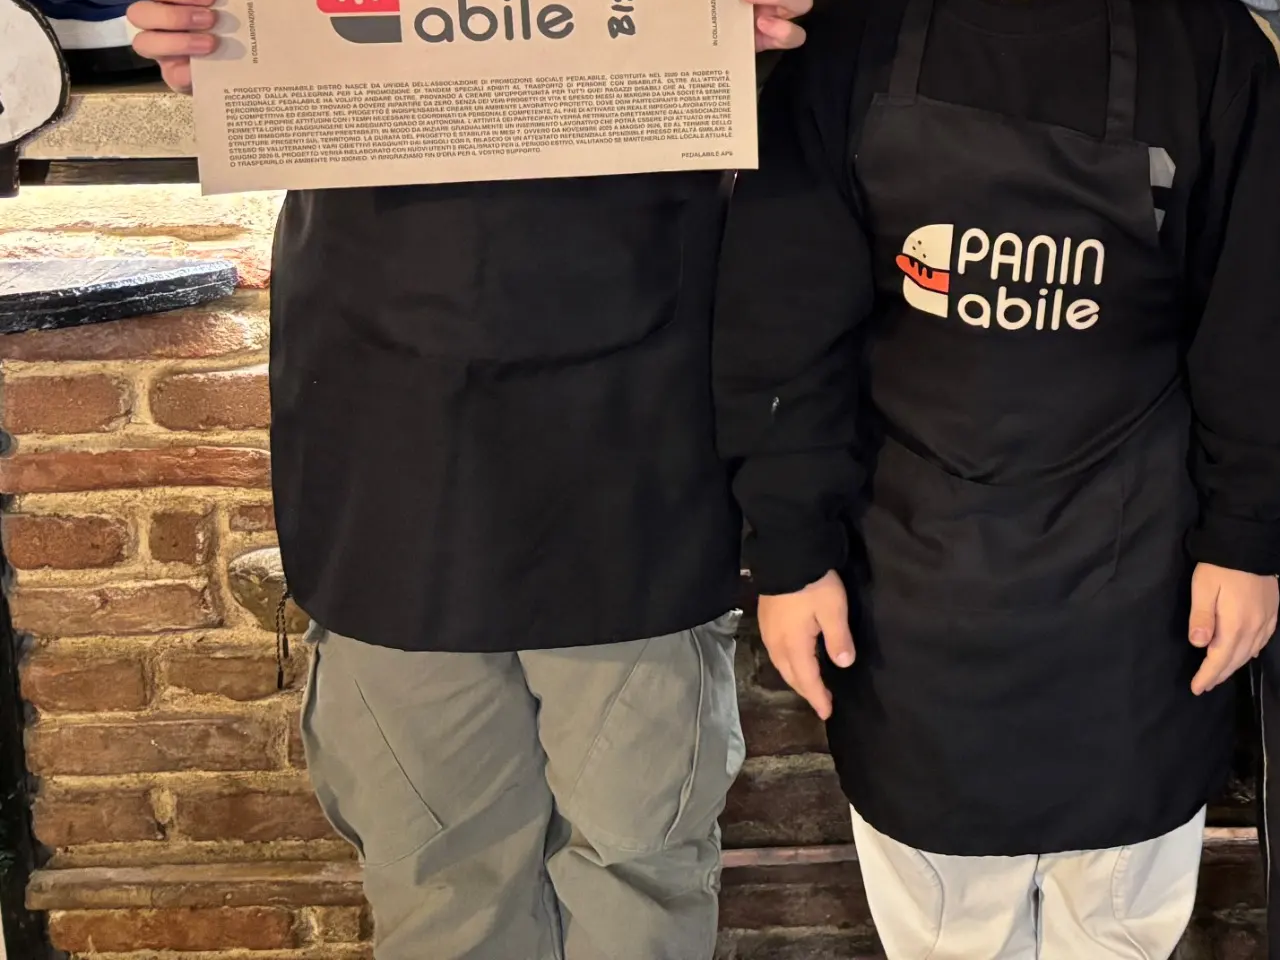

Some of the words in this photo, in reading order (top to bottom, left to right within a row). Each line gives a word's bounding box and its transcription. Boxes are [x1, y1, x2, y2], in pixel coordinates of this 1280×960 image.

[345, 82, 368, 90] NASCE
[957, 227, 1105, 286] PANIN
[957, 285, 1100, 331] abile
